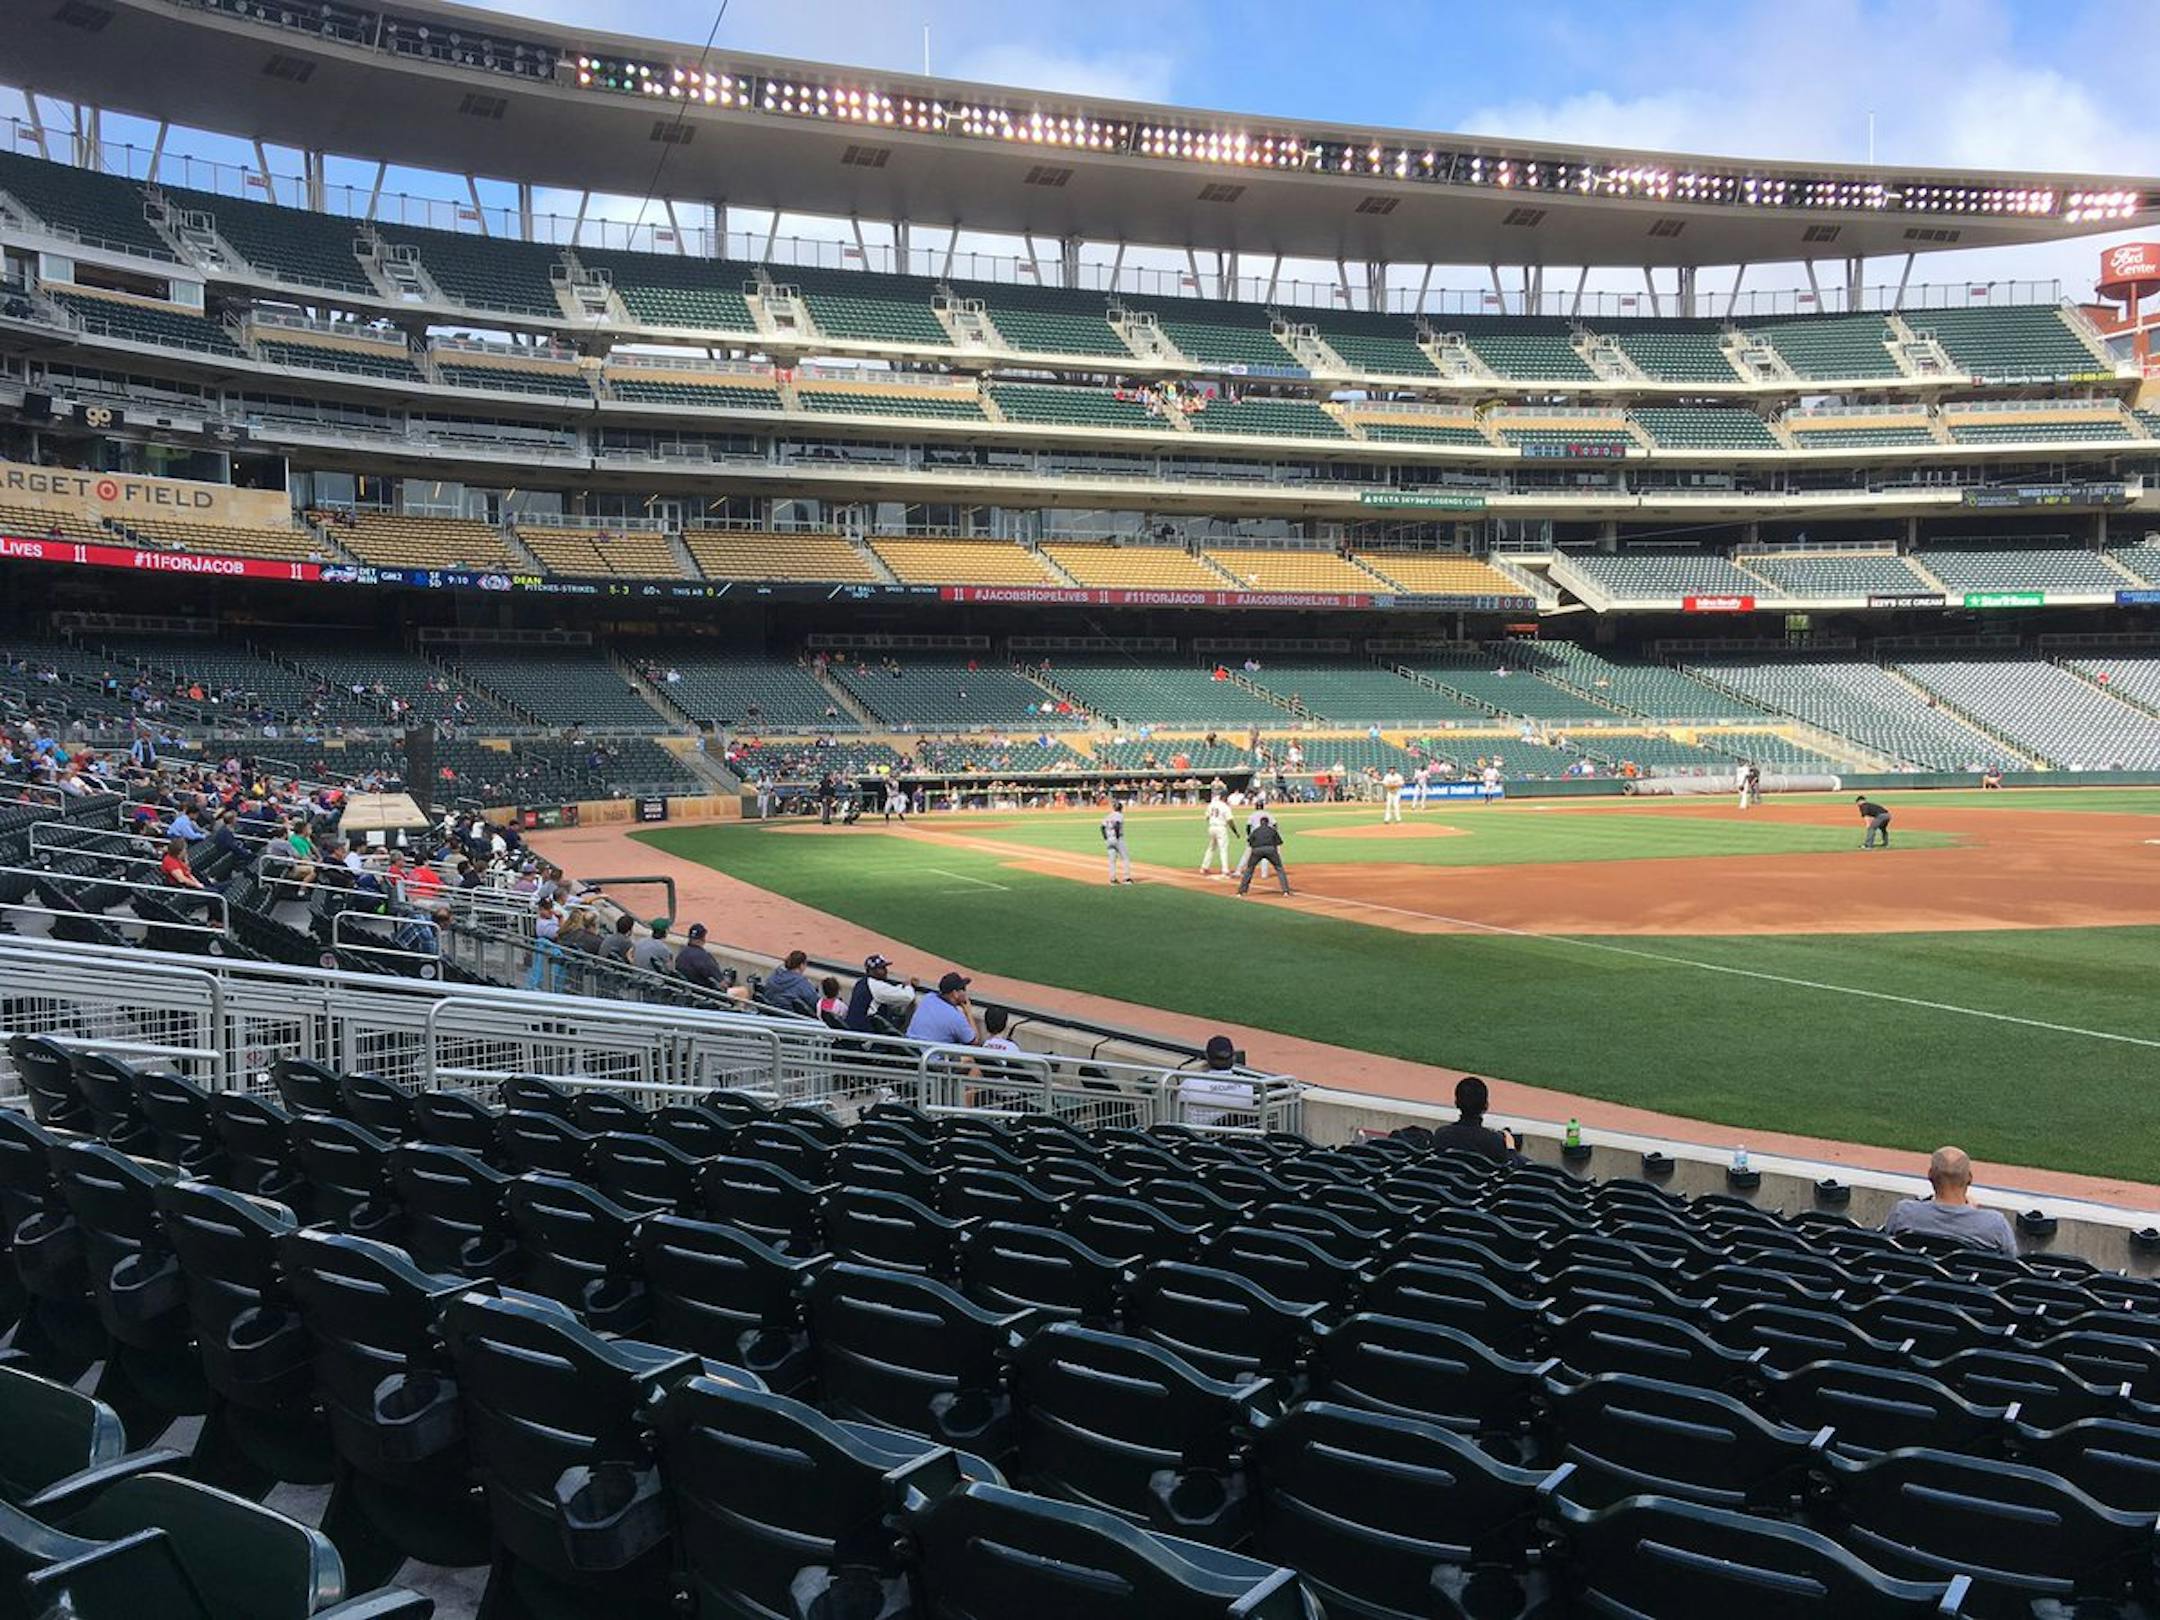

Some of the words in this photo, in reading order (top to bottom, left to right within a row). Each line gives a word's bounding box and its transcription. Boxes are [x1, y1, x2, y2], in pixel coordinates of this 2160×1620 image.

[2110, 246, 2144, 267] Ford
[2116, 264, 2156, 276] Center
[0, 469, 91, 497] RGET
[125, 484, 213, 509] FIELD
[1372, 495, 1399, 504] DELTA
[73, 544, 88, 564] 11
[133, 552, 244, 575] #11FORJACOB
[290, 562, 303, 581] 11
[512, 575, 543, 585] DEAN
[975, 588, 1088, 602] #JACOBSHOPELIVES
[1124, 591, 1206, 604] #11FORJACOB
